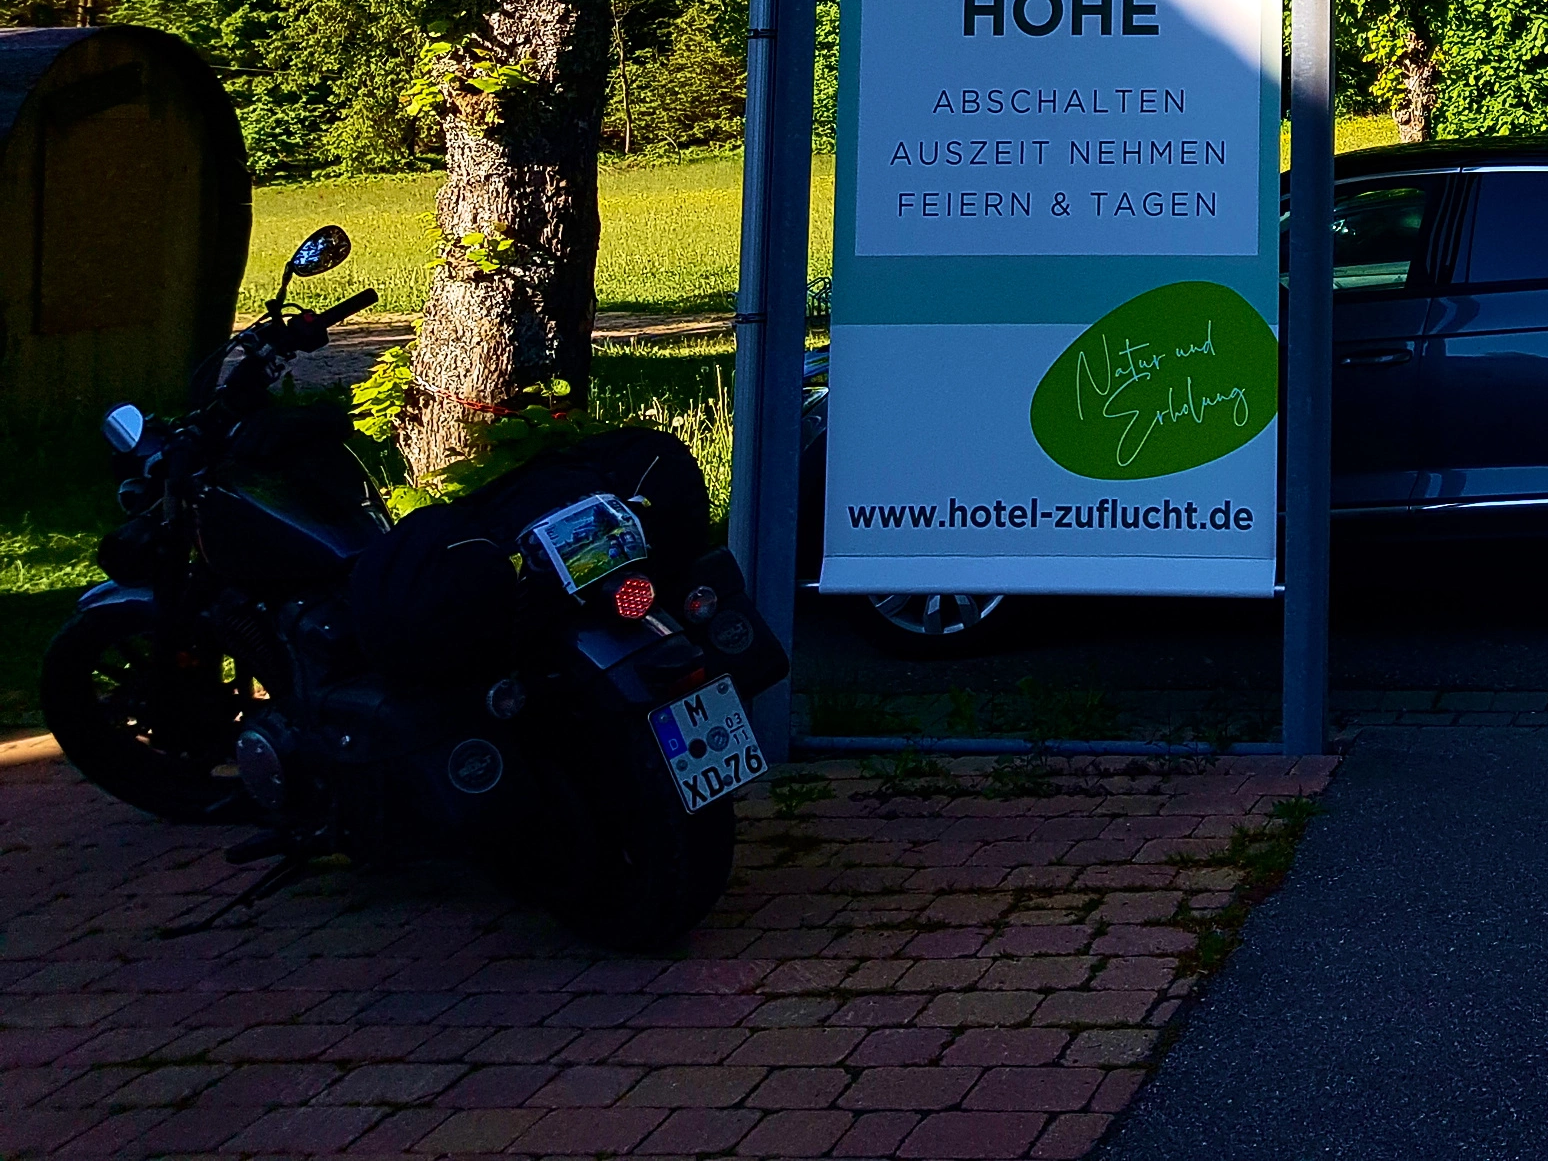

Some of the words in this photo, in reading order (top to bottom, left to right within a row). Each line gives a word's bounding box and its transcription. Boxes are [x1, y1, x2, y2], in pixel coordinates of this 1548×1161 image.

[932, 88, 1187, 115] ABSCHALTEN
[890, 141, 1050, 167] AUSZEIT
[1069, 141, 1227, 167] NEHMEN
[897, 192, 1032, 219] FEIERN
[1050, 192, 1071, 219] &
[1091, 192, 1218, 219] TAGEN
[1076, 334, 1166, 421] Natur
[1175, 320, 1216, 358] und
[1103, 372, 1249, 467] Erholung
[847, 497, 1255, 532] www.hotel-zuflucht.de
[684, 694, 709, 727] M
